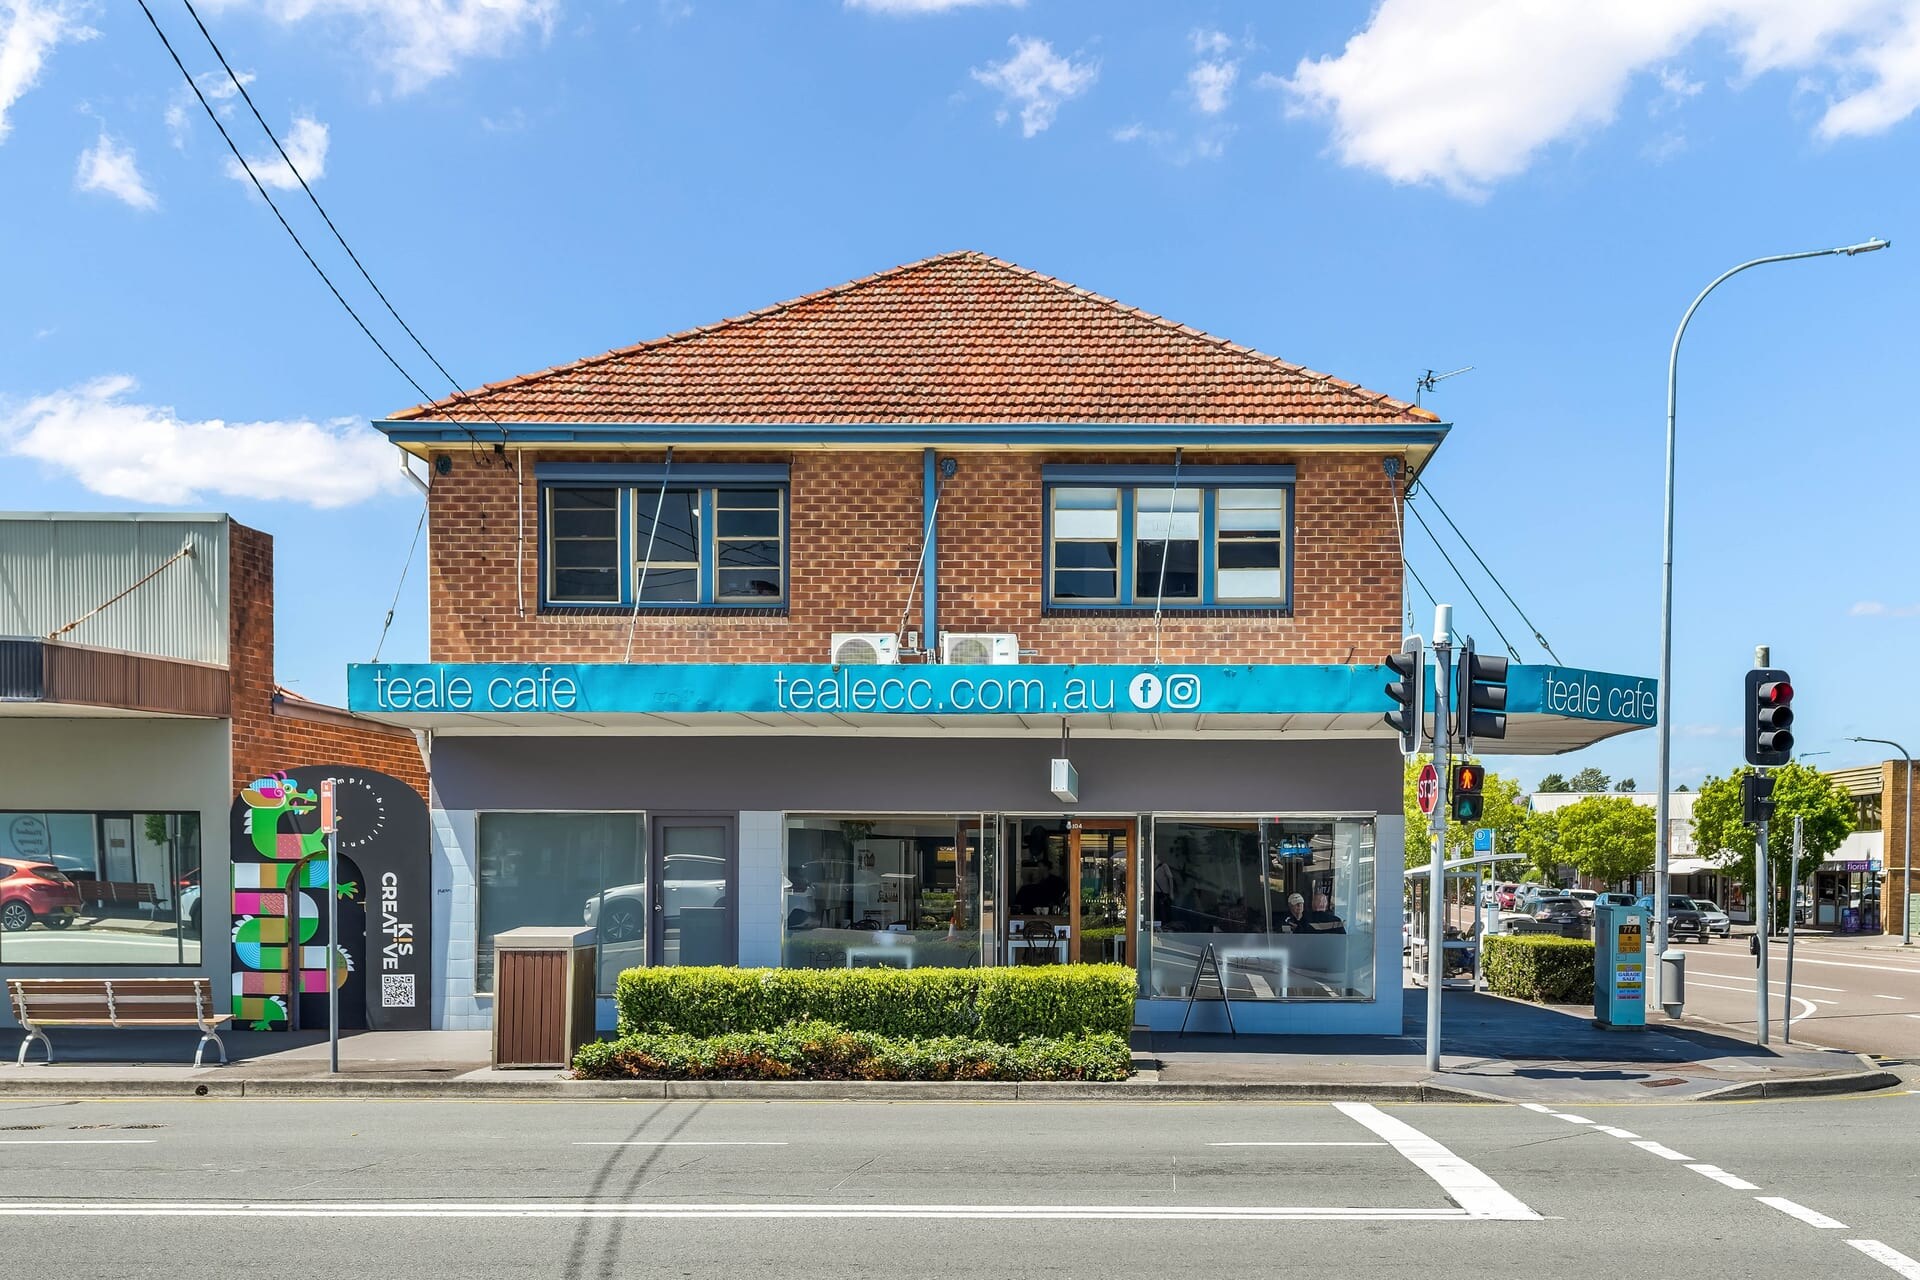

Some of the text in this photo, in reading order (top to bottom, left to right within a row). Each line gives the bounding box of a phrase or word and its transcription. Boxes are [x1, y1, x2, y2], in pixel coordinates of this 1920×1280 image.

[373, 667, 577, 708] teale cafe
[773, 670, 1115, 709] tealecc.com.au
[1546, 671, 1655, 720] teale cafe
[1419, 780, 1437, 798] STOP
[1847, 862, 1868, 870] florist
